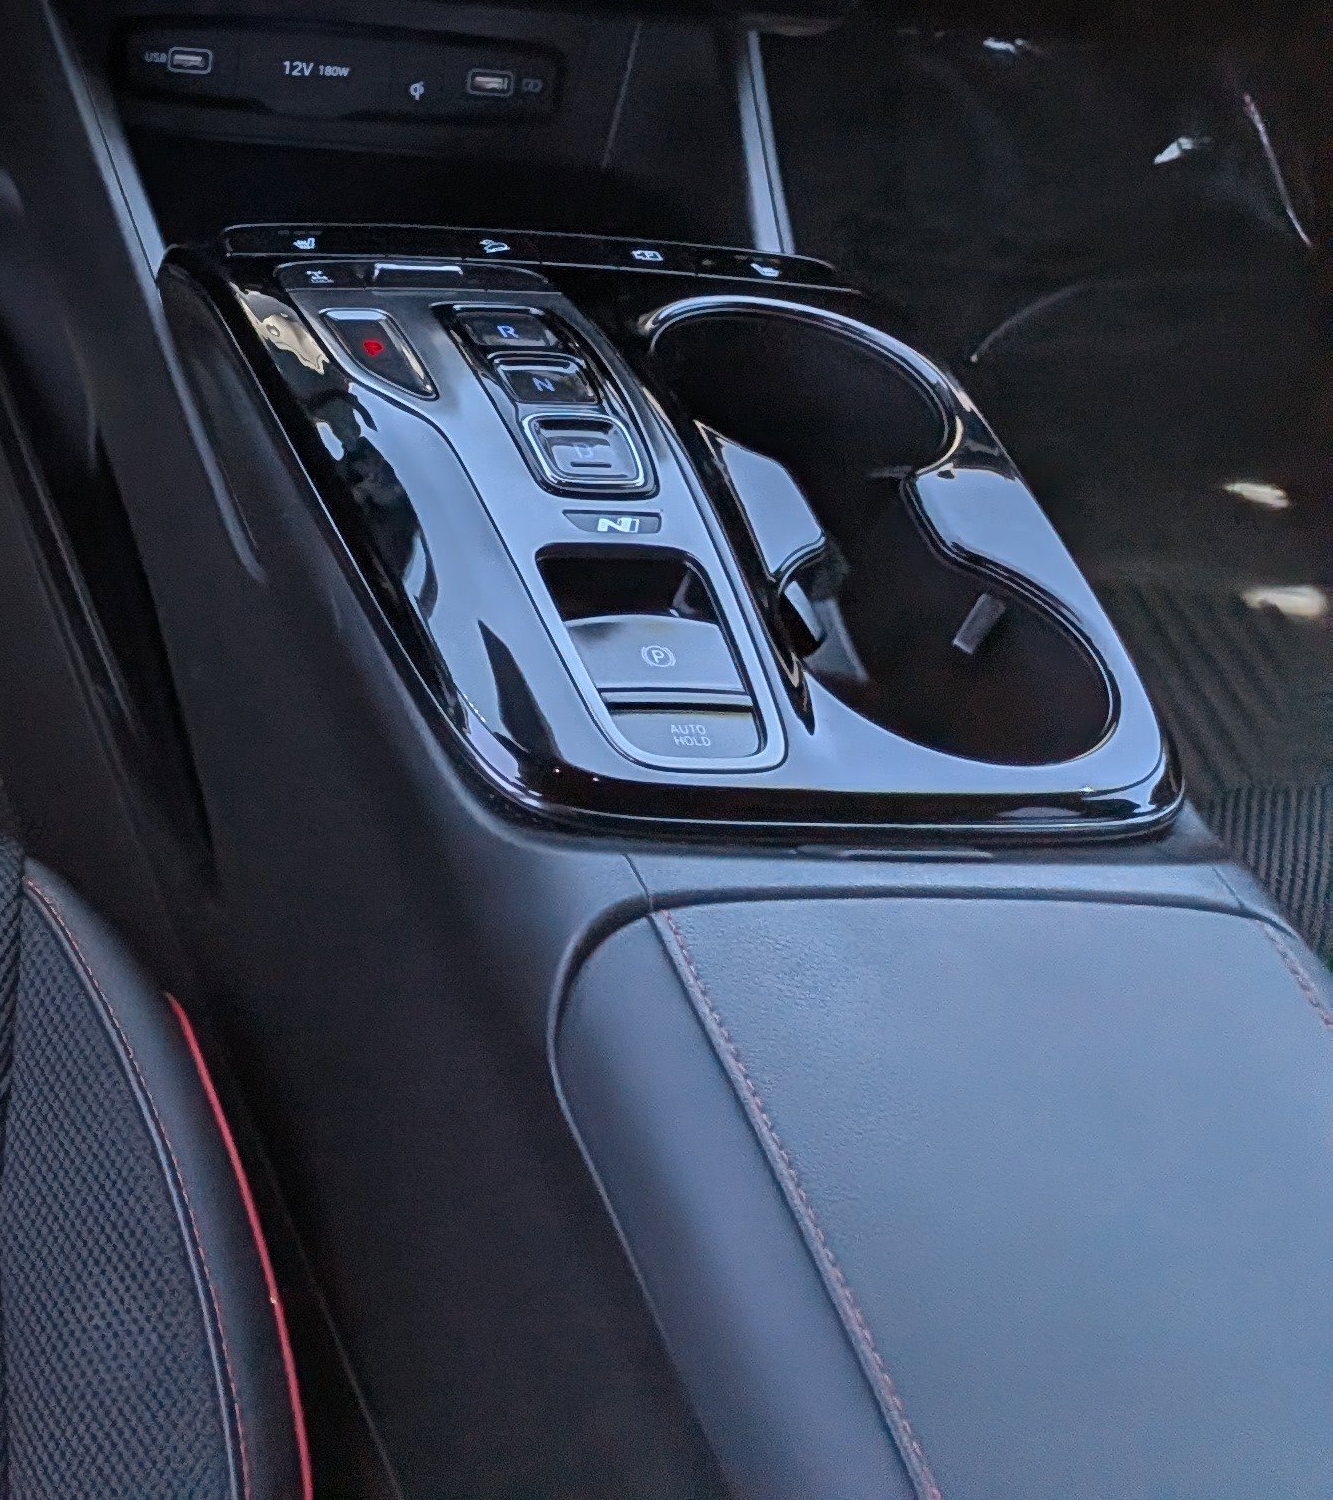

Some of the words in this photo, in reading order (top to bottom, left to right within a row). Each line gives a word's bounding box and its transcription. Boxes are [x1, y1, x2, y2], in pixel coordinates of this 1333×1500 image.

[283, 60, 314, 76] 12V
[318, 64, 351, 77] 180W
[497, 325, 518, 338] R
[533, 377, 558, 392] N
[670, 724, 706, 735] AUTO
[674, 736, 711, 747] HOLD
